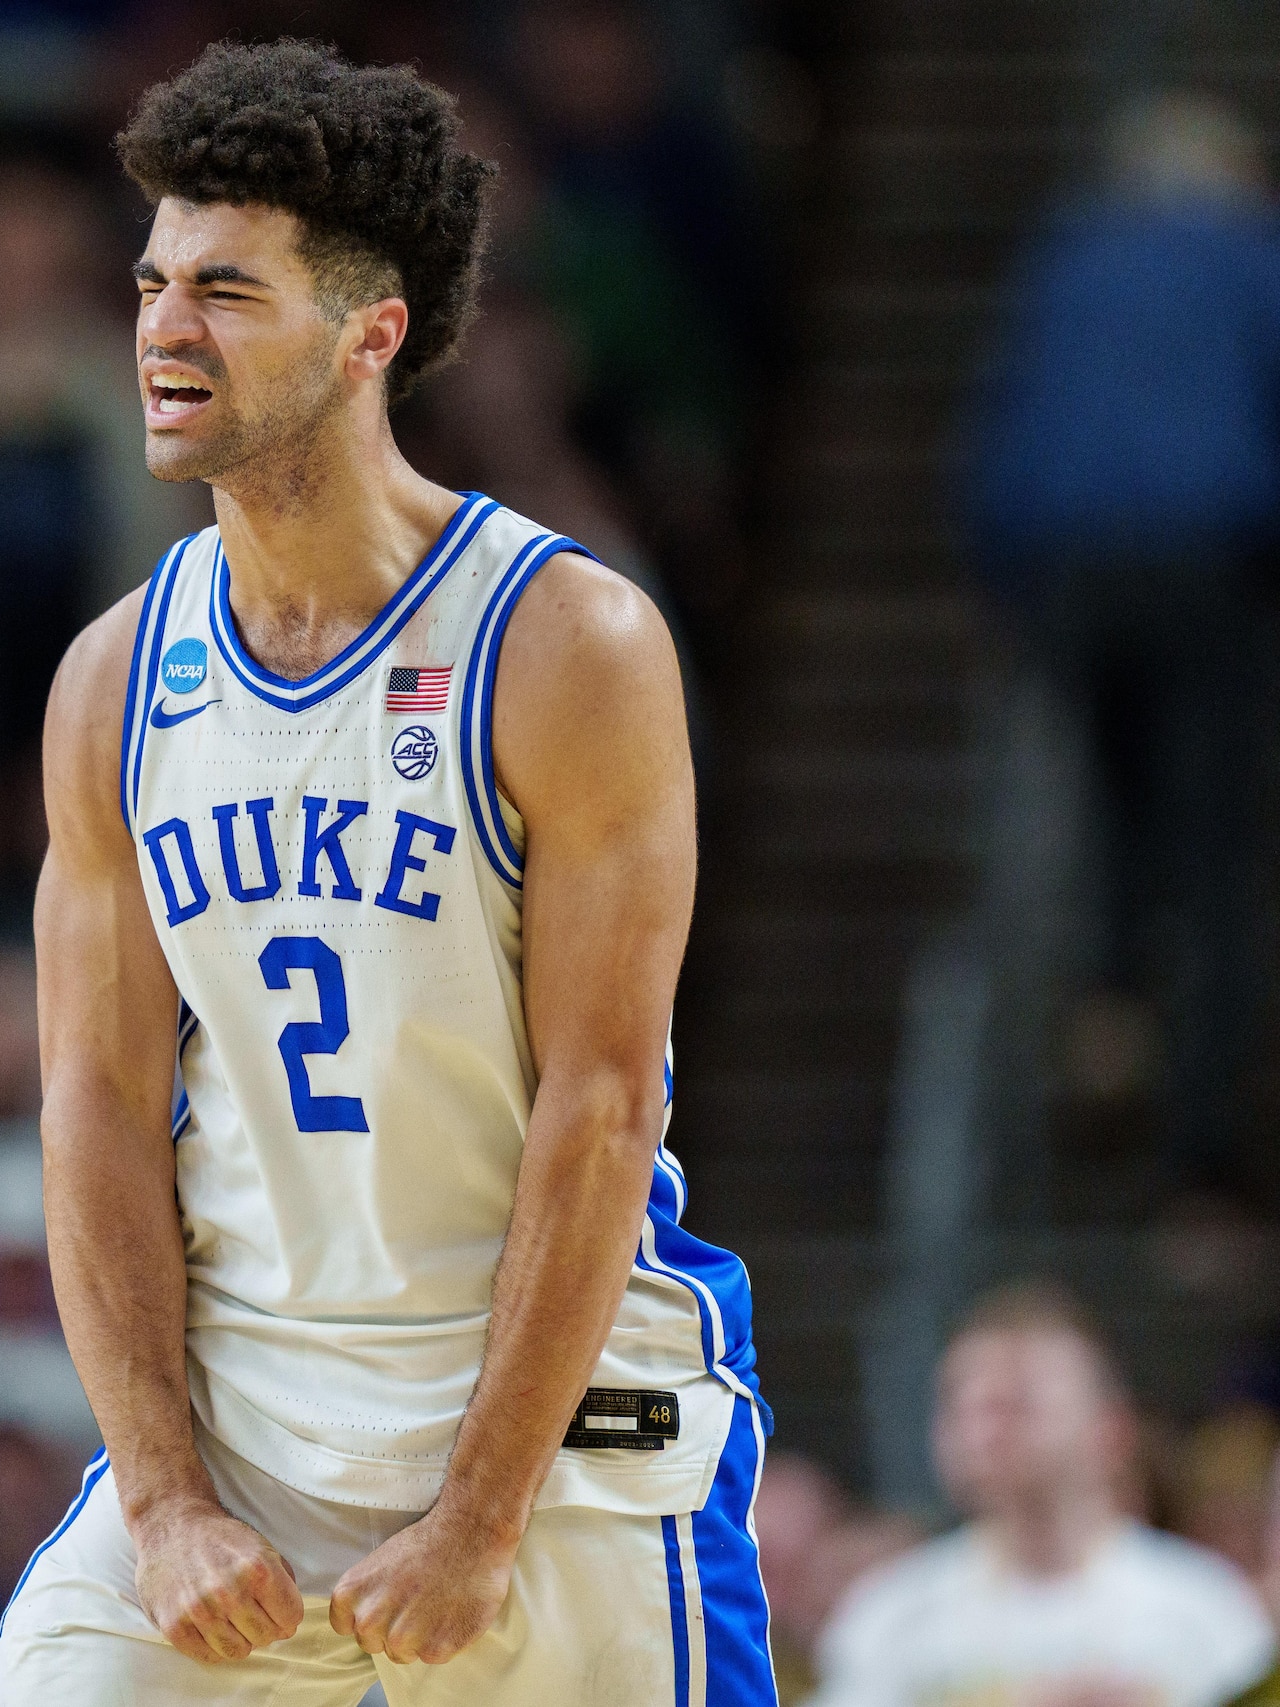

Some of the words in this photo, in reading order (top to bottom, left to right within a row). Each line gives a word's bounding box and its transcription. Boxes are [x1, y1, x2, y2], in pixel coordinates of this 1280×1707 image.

[165, 663, 204, 679] NCAA
[397, 743, 436, 755] ACC
[142, 796, 457, 928] DUKE
[258, 936, 370, 1132] 2
[586, 1395, 638, 1403] ENGINEERED
[648, 1405, 671, 1424] 48
